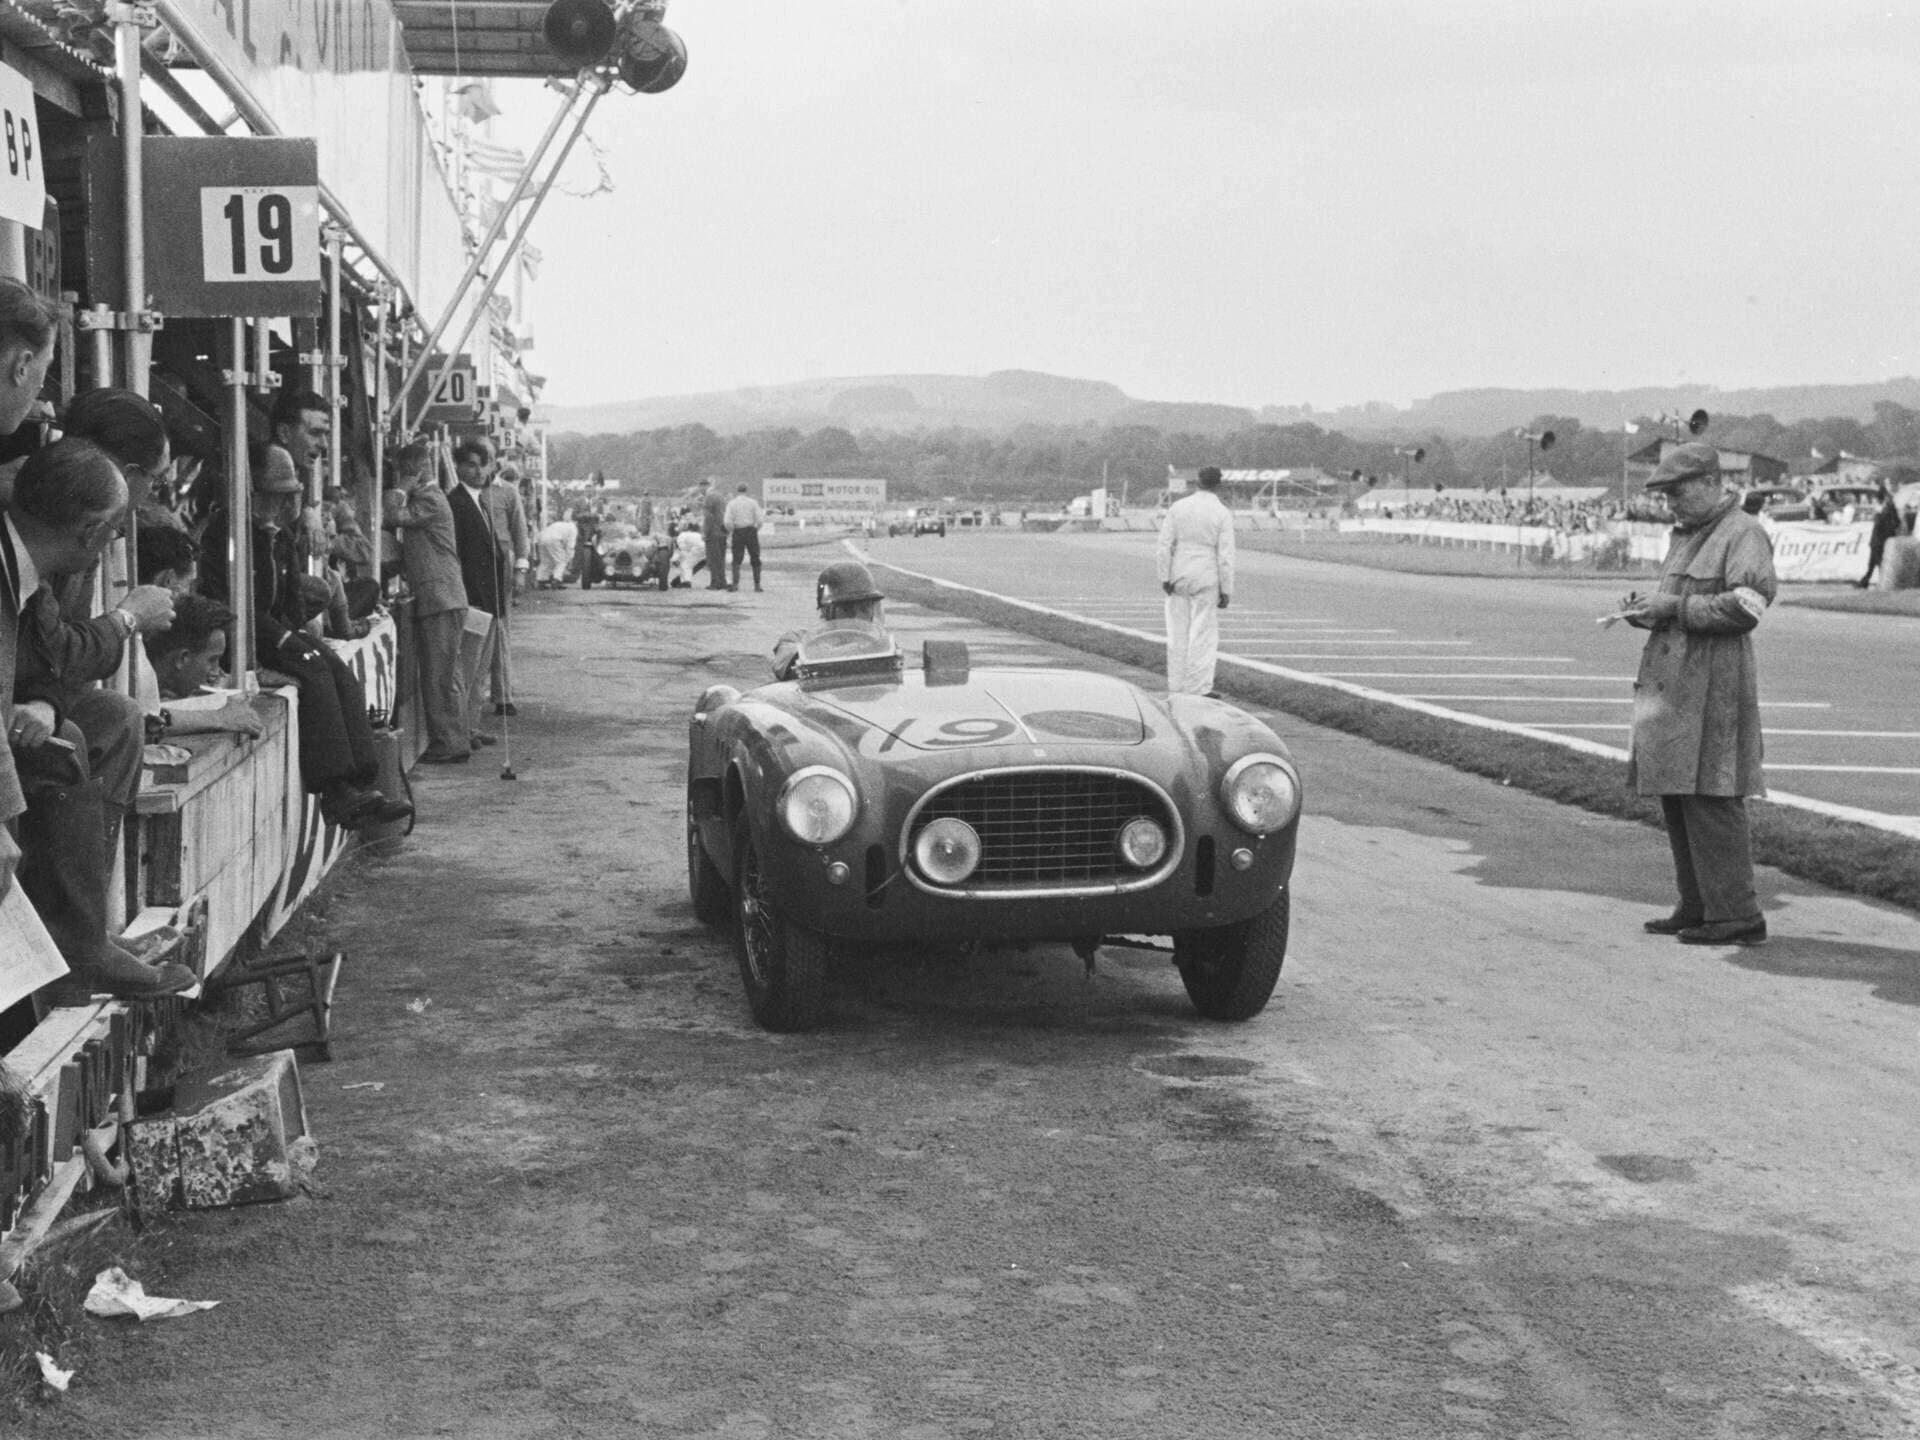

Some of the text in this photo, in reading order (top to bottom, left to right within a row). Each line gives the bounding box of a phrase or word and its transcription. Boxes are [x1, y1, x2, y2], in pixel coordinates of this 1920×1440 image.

[4, 108, 32, 182] BP
[224, 193, 294, 275] 19
[434, 373, 465, 404] 20
[827, 485, 861, 495] MOTOR
[1220, 469, 1291, 481] UNLOP
[878, 718, 1017, 753] 19
